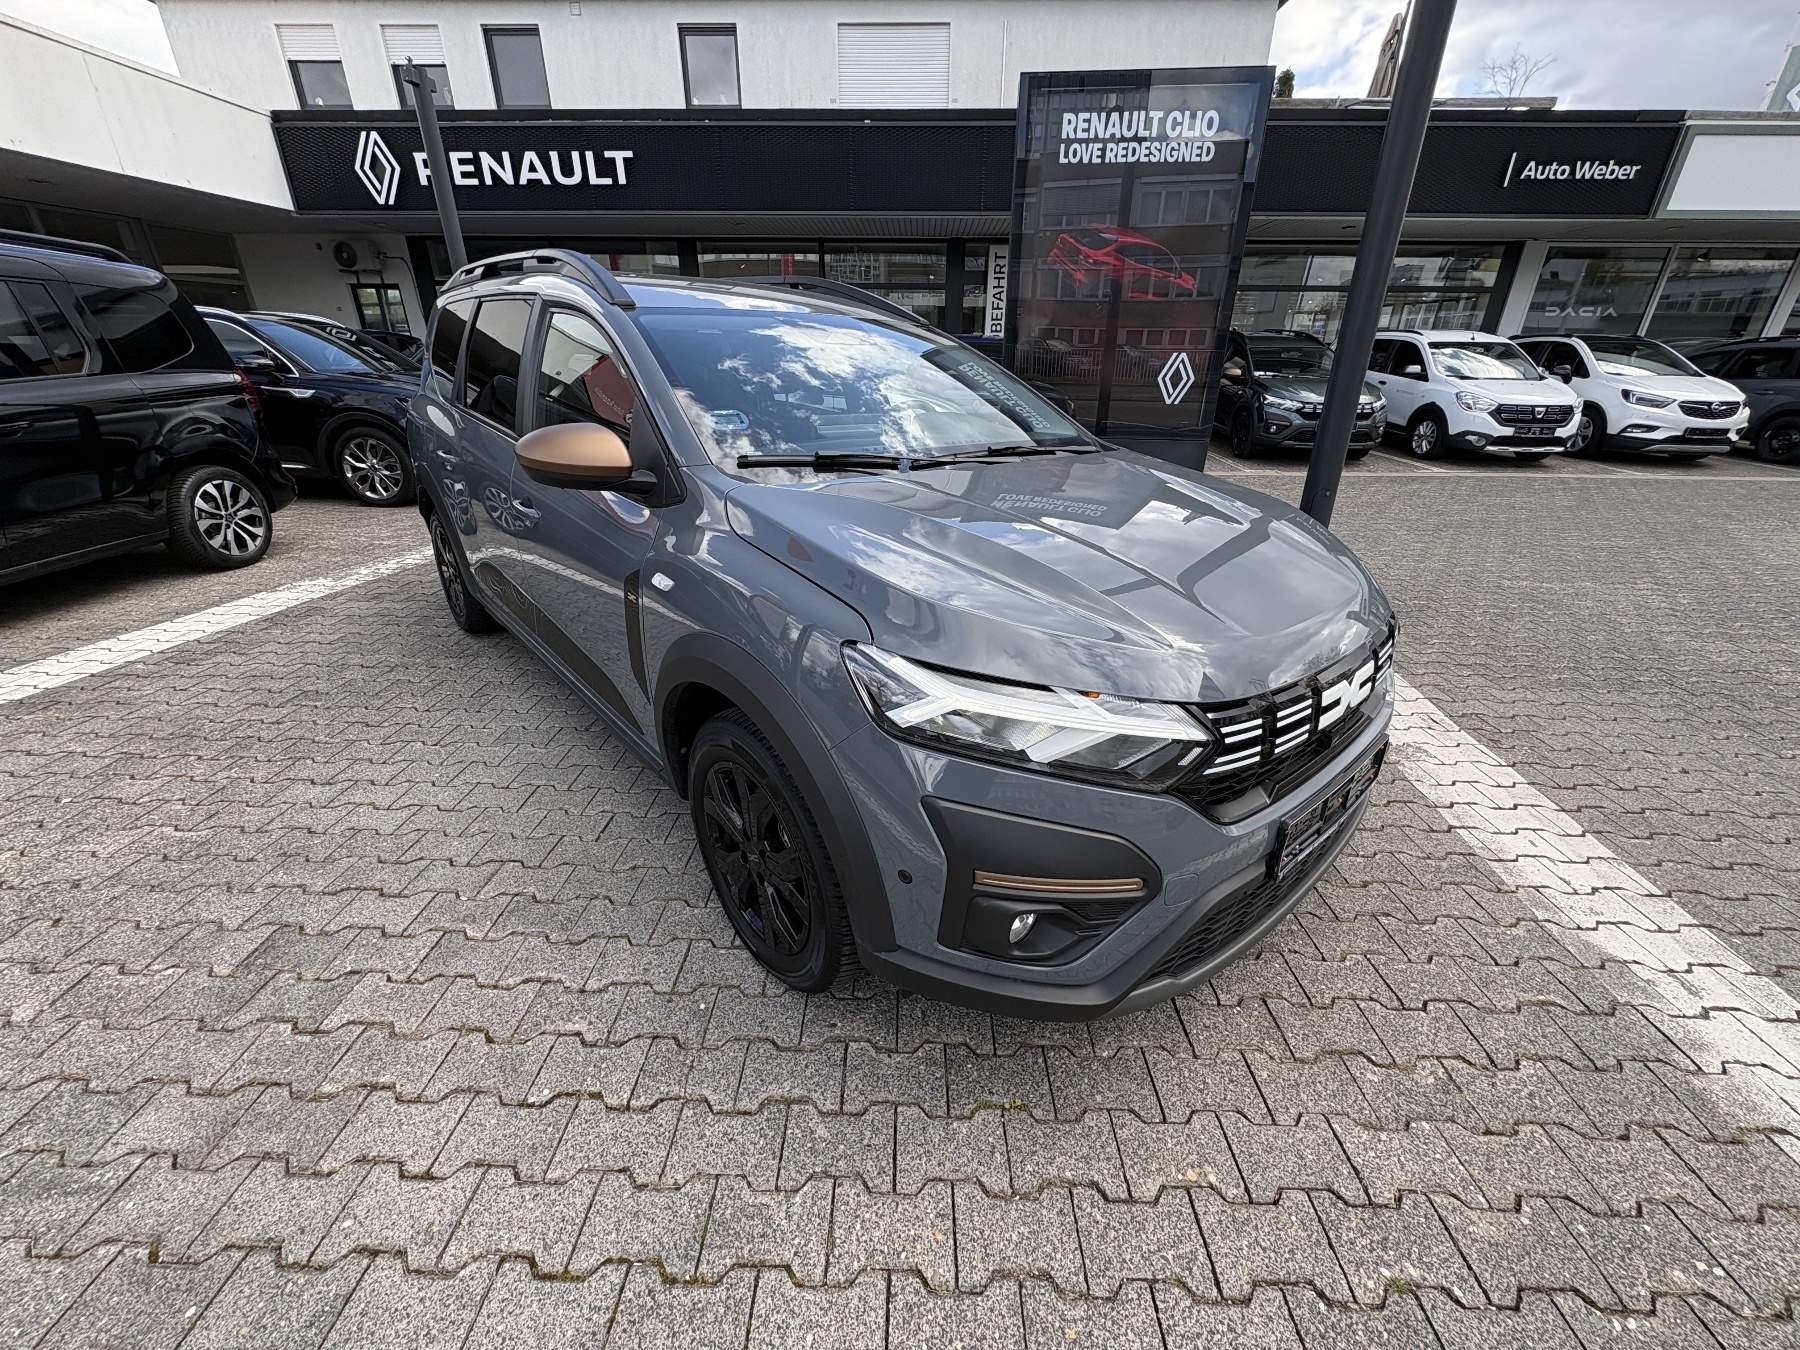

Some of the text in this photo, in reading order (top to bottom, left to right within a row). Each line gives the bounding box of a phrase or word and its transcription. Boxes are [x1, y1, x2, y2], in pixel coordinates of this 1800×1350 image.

[1061, 110, 1219, 139] RENAULT CLIO
[1059, 141, 1215, 164] LOVE REDESIGNED
[1520, 160, 1642, 180] Auto Weber
[990, 251, 1008, 337] BEFAHRT
[1544, 306, 1617, 317] DACIA
